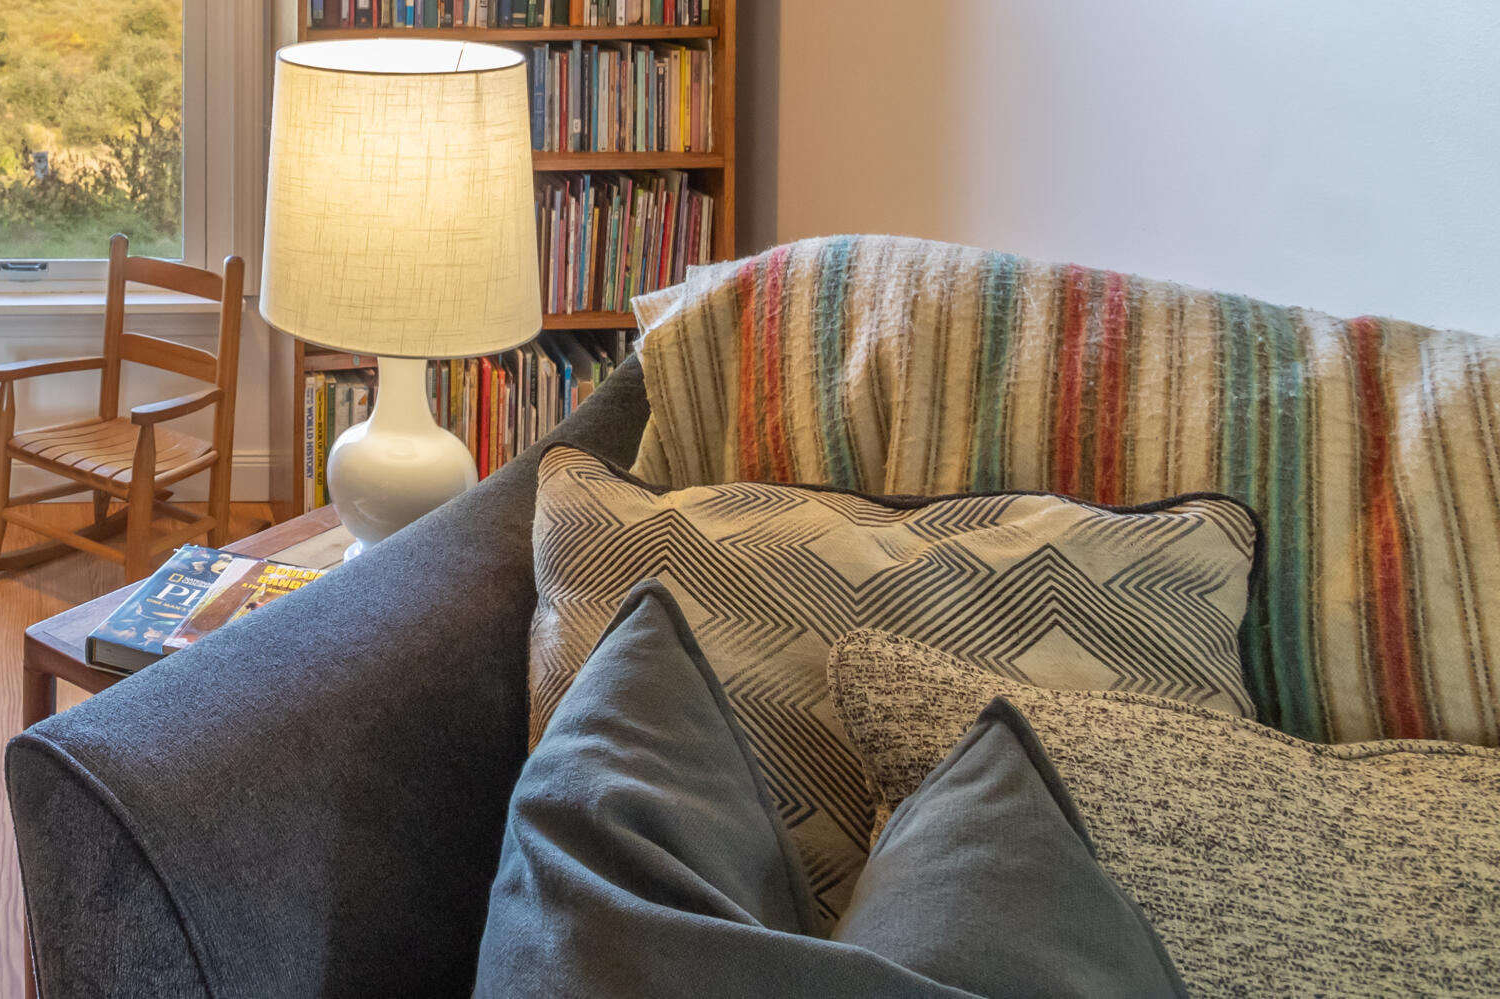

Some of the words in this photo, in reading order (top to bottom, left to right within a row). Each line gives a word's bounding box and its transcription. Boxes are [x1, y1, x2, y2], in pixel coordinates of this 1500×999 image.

[306, 406, 314, 439] WORLD
[316, 421, 324, 441] BOOK
[305, 441, 314, 479] HISTORY
[256, 574, 309, 590] BANG
